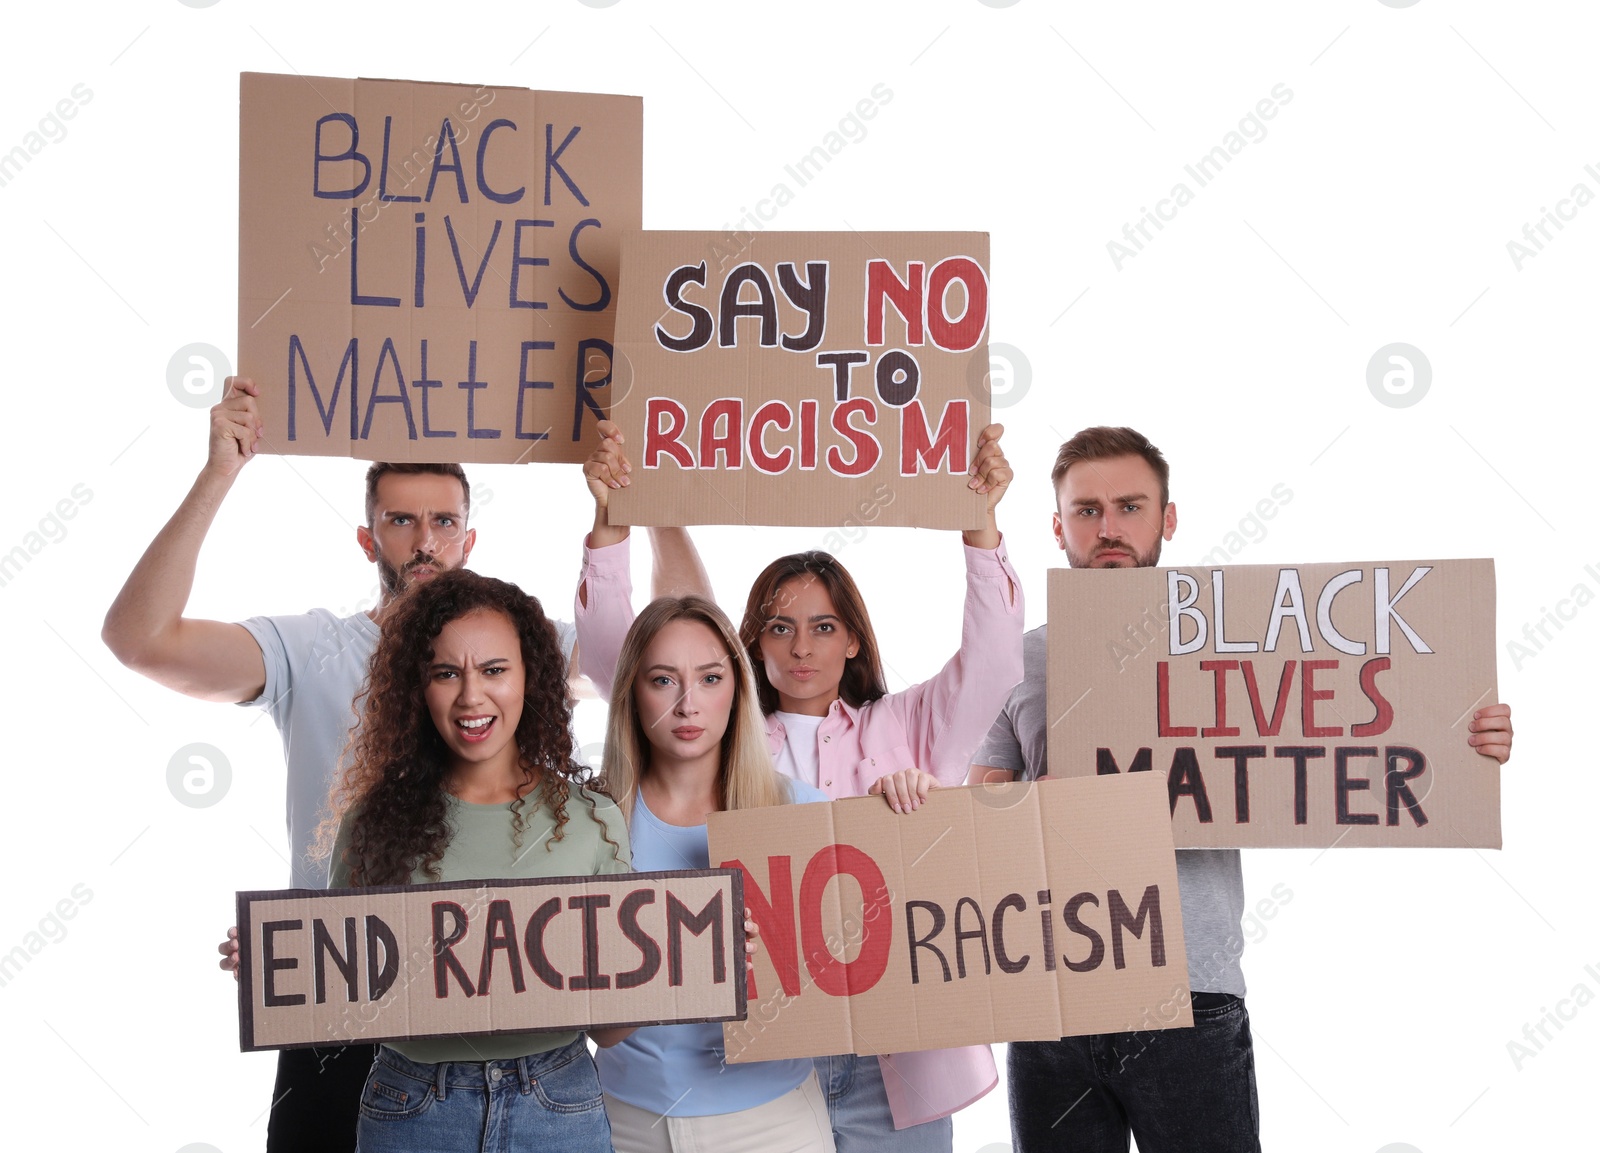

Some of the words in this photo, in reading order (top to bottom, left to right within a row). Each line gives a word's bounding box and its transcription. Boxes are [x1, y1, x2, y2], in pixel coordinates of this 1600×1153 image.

[313, 112, 590, 207] BLACK
[654, 259, 830, 353] SAY
[864, 255, 990, 353] NO
[816, 349, 921, 409] TO
[642, 396, 971, 479] RACISM
[1167, 566, 1435, 656] BLACK
[1156, 657, 1395, 738] LIVES
[261, 914, 400, 1008] END
[431, 888, 727, 999] RACISM
[720, 843, 893, 1000] NO
